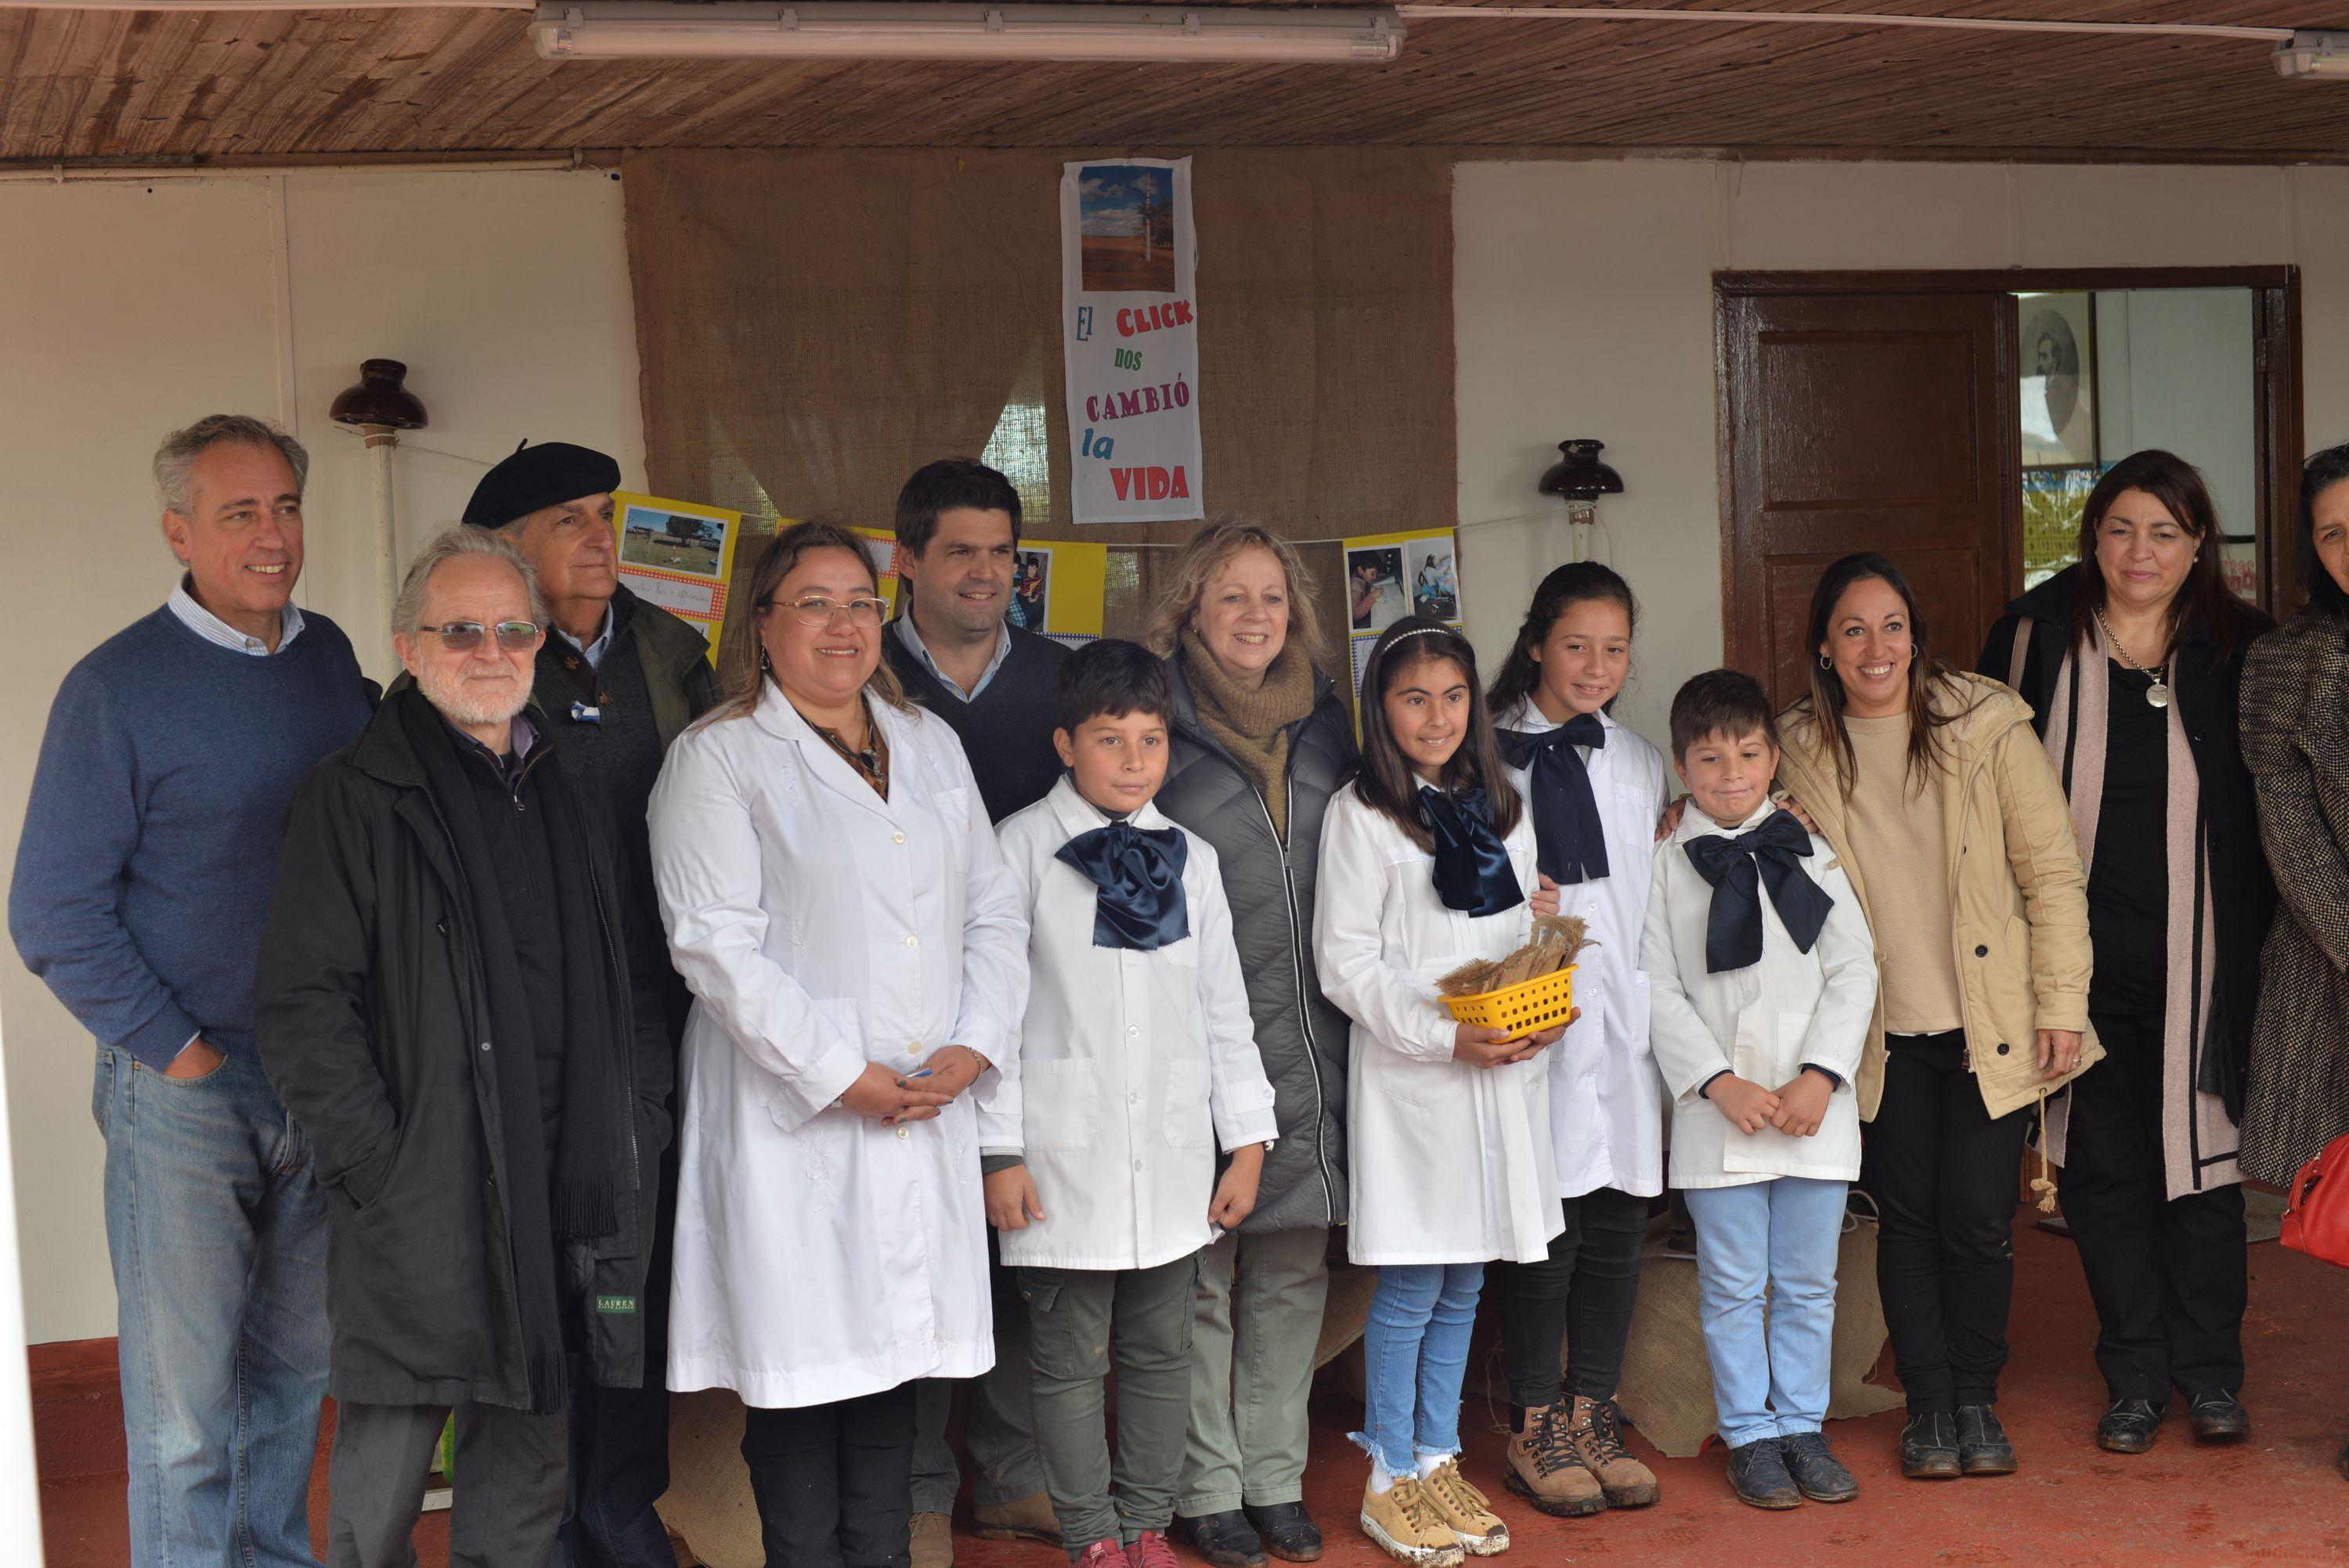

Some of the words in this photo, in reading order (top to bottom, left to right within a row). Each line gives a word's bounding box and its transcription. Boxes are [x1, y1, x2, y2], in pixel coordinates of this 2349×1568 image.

[1076, 306, 1093, 341] El
[1116, 299, 1194, 337] CLICK
[1114, 348, 1142, 371] nos
[1086, 373, 1189, 423] CAMBIÓ
[1081, 427, 1114, 460] la
[1109, 465, 1189, 501] VIDA
